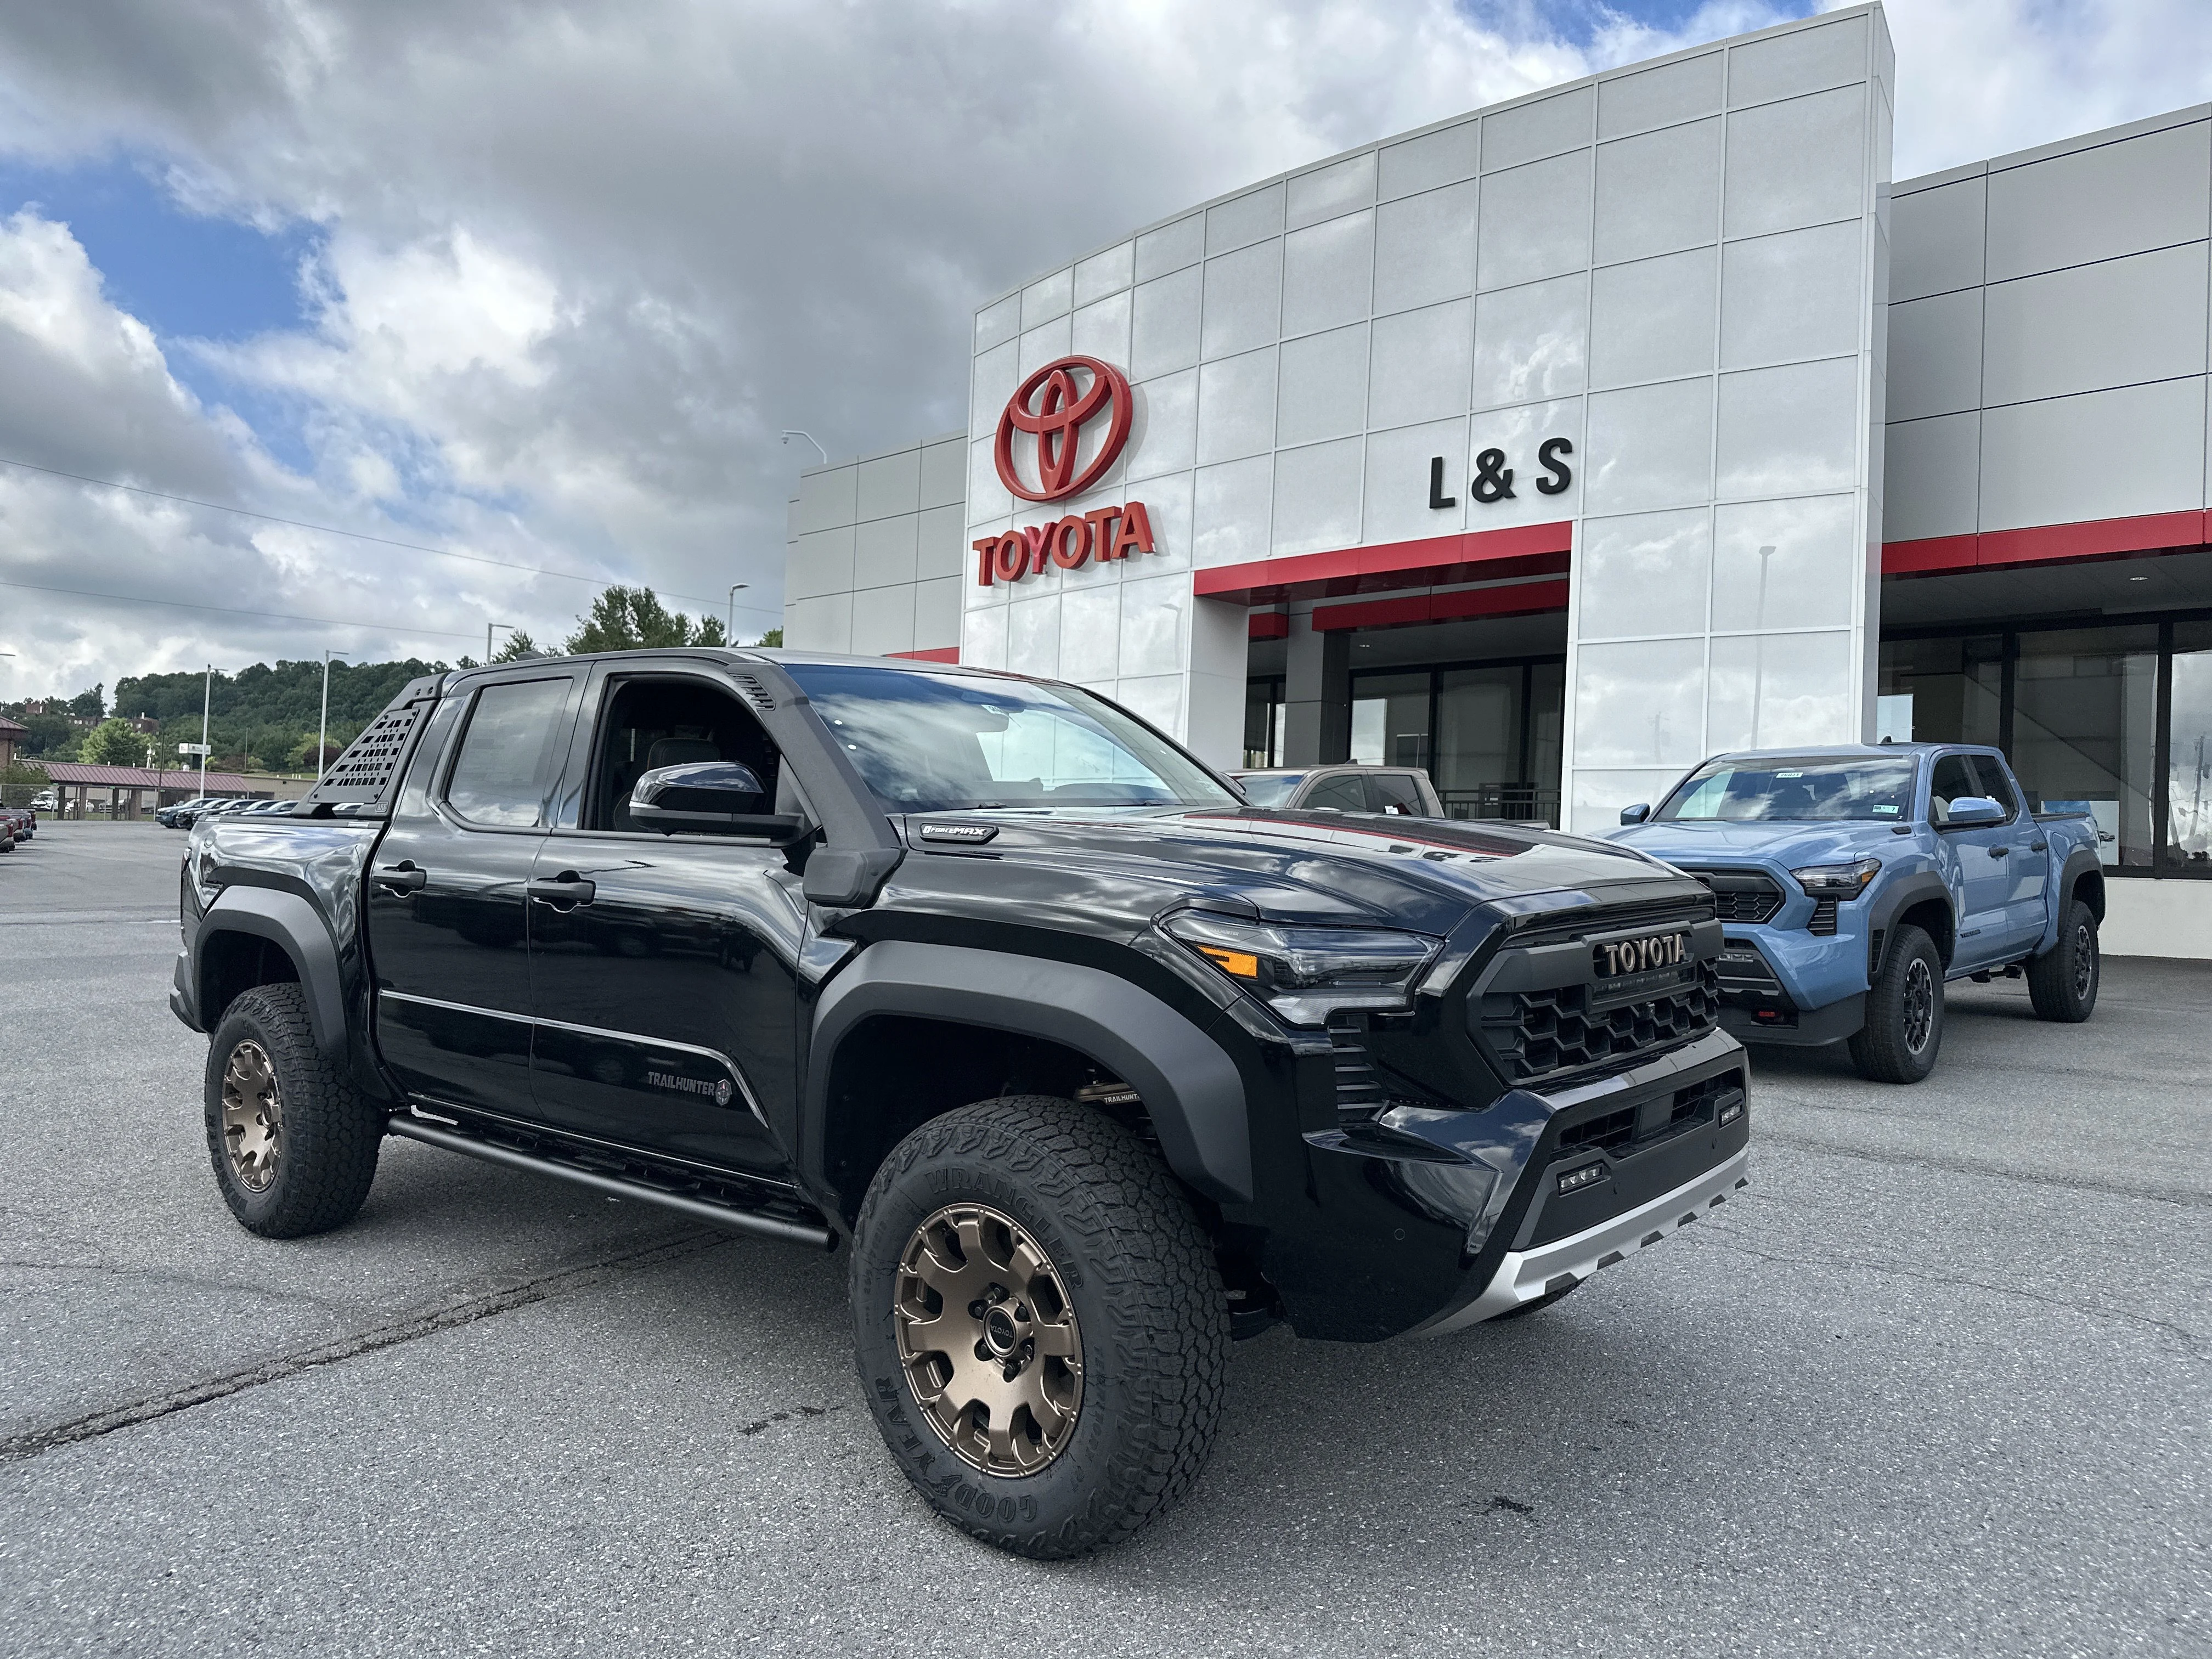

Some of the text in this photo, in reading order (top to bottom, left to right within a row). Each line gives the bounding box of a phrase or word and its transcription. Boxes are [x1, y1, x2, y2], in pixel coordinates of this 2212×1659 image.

[1430, 437, 1572, 509] L & S
[973, 501, 1156, 586] TOYOTA
[1604, 934, 1687, 975] TOYOTA
[648, 1071, 715, 1096] TRAILHUNTER
[924, 1166, 1084, 1289] WRANGLER
[990, 1324, 1013, 1338] TOYOTA
[876, 1376, 1037, 1523] GOODYEAR
